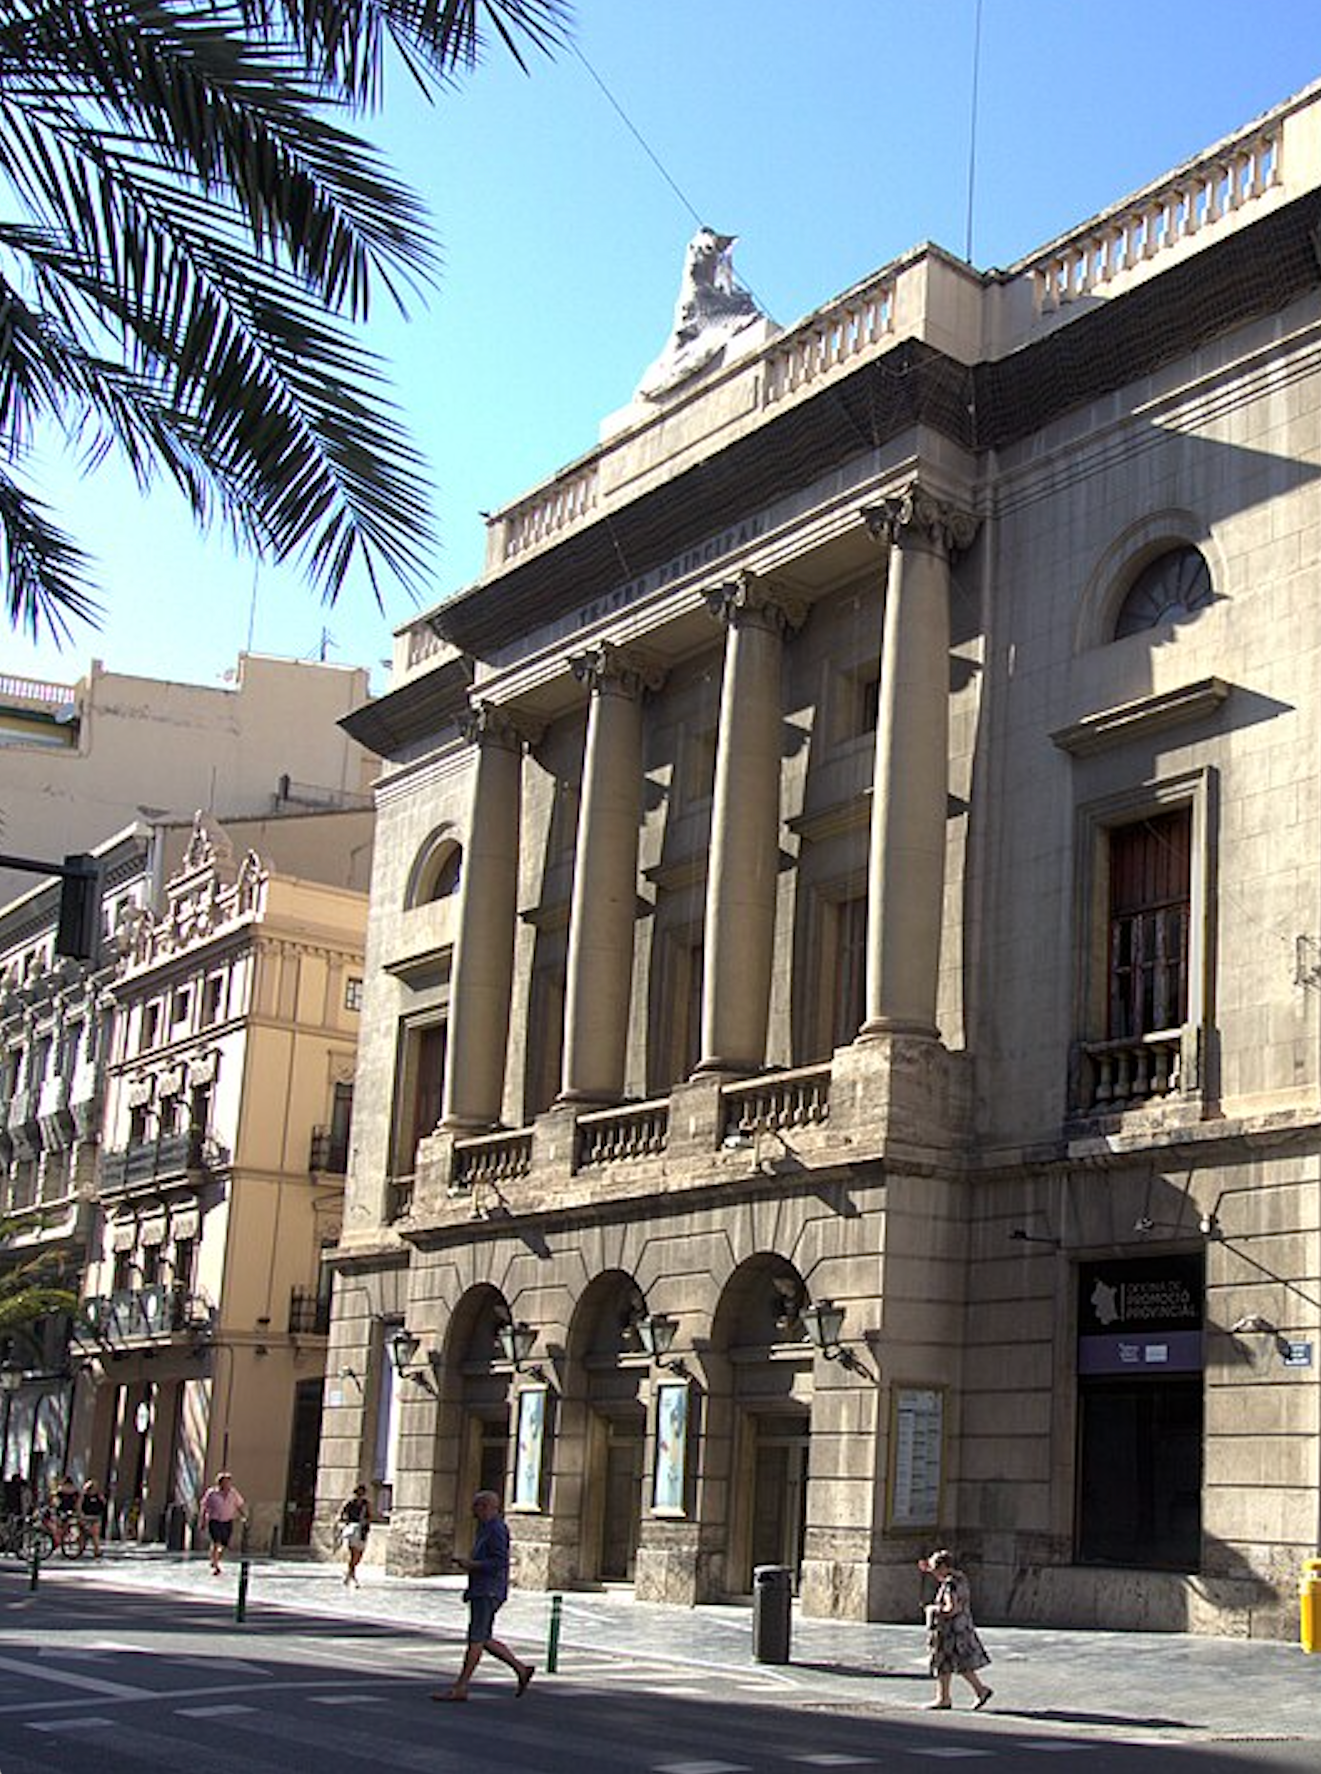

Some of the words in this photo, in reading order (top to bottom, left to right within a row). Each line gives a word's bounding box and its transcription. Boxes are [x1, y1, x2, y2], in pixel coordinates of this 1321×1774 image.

[579, 578, 647, 626] TEATRO
[659, 518, 765, 586] PRINCIPAL
[1126, 1304, 1198, 1319] PROVINCIAL
